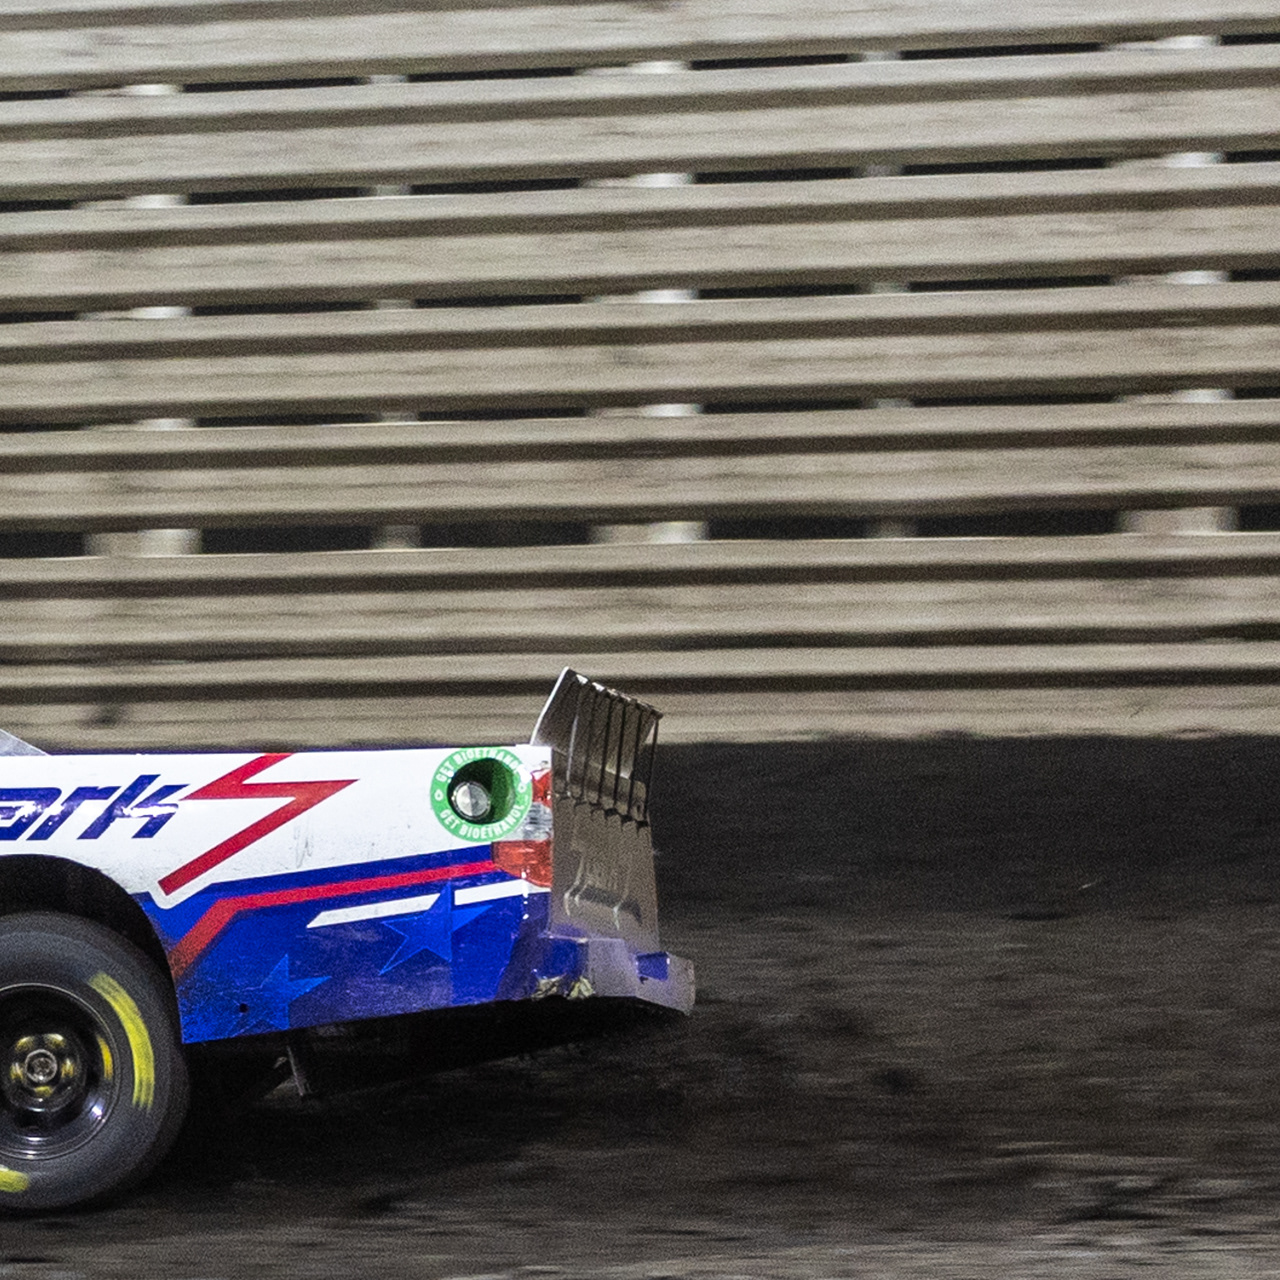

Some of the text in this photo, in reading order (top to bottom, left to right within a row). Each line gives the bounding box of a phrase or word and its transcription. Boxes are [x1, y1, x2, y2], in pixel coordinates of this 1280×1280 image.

[435, 747, 526, 783] GET BIOETHANO
[440, 804, 525, 839] GET BIOETHANOL
